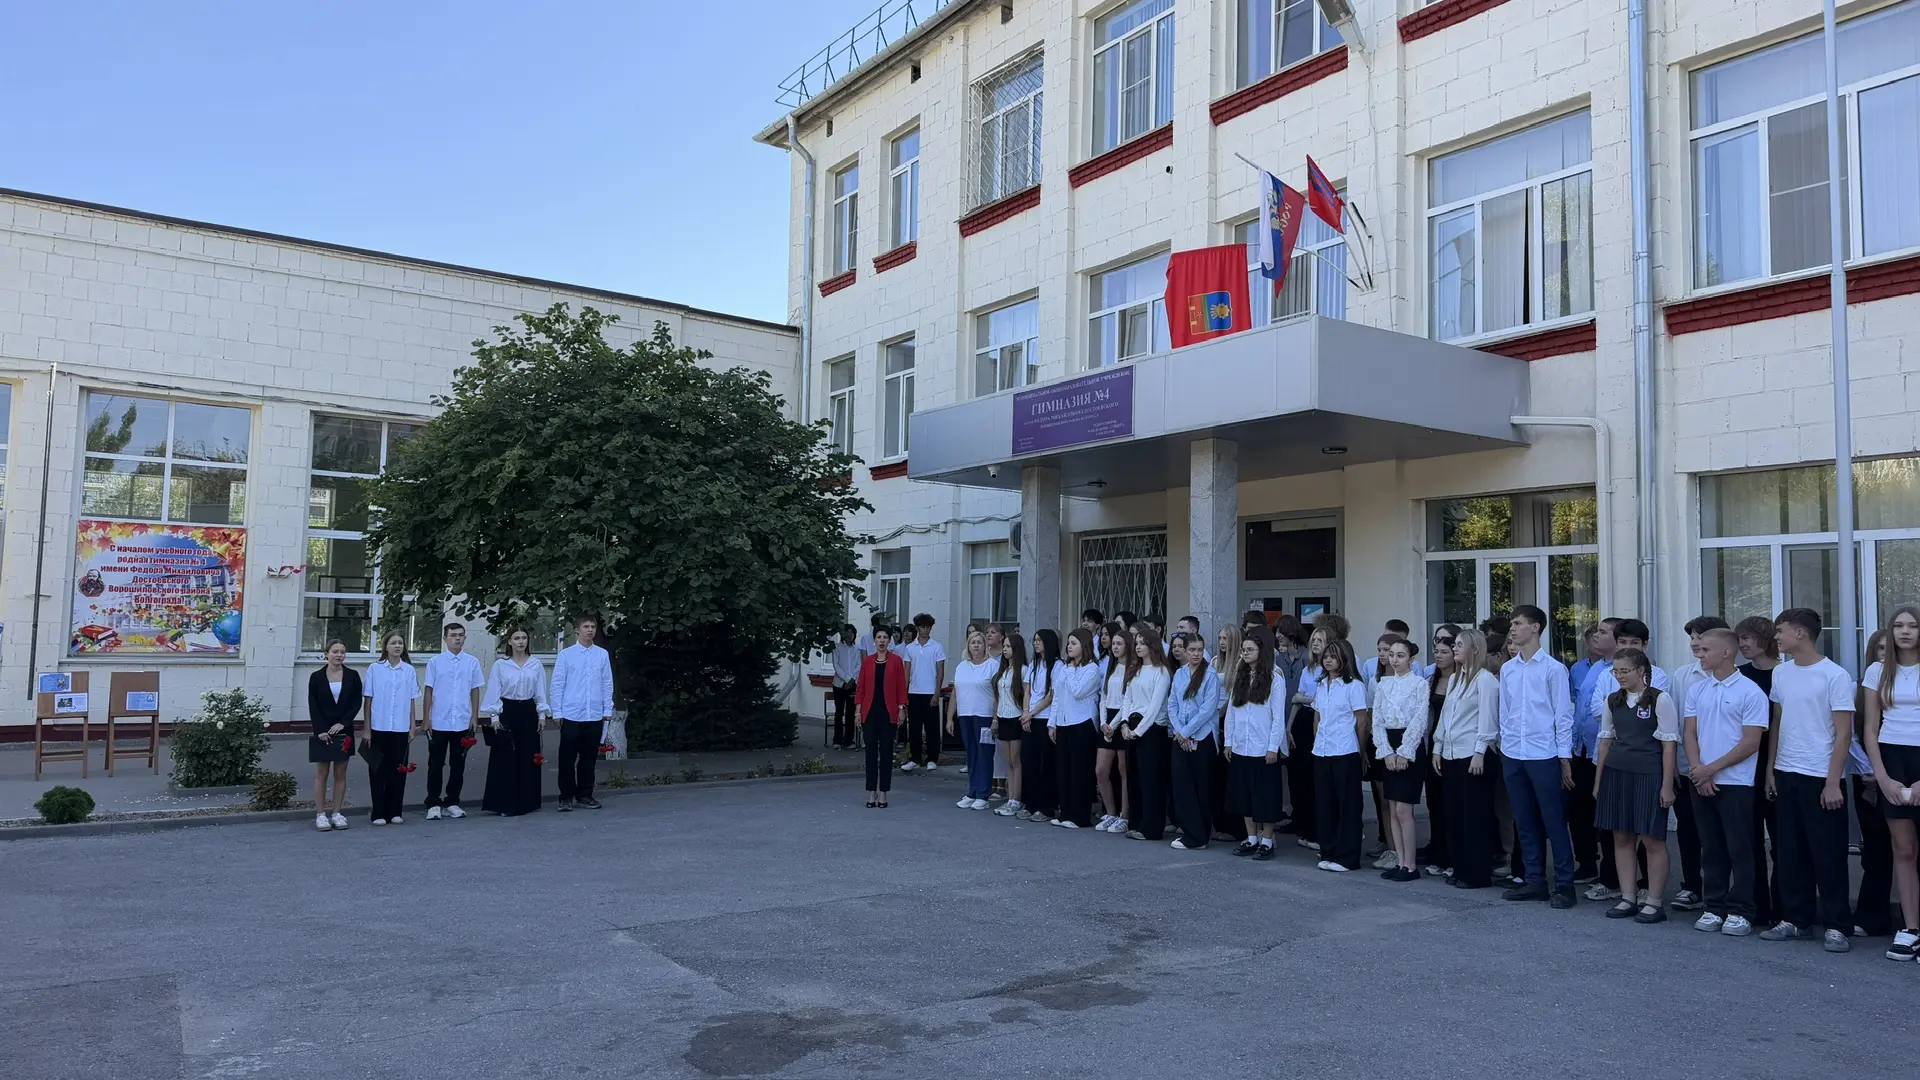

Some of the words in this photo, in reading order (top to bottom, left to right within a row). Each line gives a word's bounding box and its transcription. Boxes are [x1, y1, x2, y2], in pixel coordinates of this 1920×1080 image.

[1031, 392, 1090, 415] ГИМНАЗИЯ
[1093, 388, 1109, 402] №4
[150, 558, 190, 566] гимназия
[130, 566, 163, 574] Федора
[132, 576, 189, 584] Достоевского
[108, 585, 179, 594] Ворошиловского
[134, 595, 184, 604] Волгограда!
